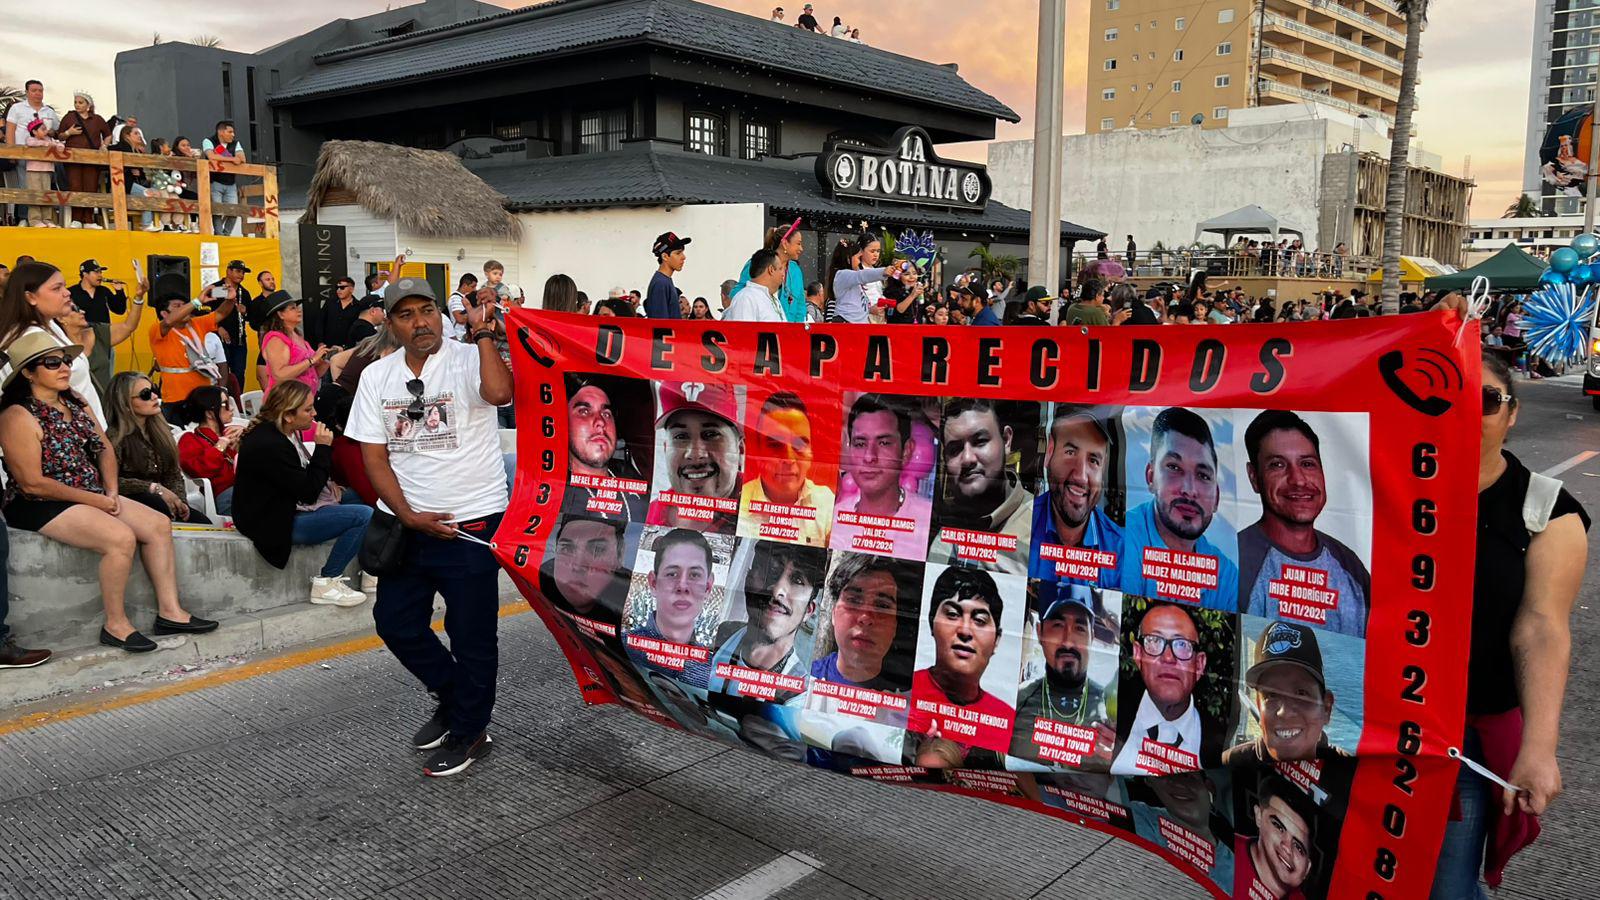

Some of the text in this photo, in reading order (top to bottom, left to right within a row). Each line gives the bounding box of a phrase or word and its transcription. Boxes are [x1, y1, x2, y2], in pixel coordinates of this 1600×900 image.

[900, 136, 926, 162] LA
[860, 155, 959, 200] BOTANA
[596, 324, 1293, 397] DESAPARECIDOS
[571, 475, 590, 485] RAFAEL
[592, 477, 599, 486] DE
[618, 480, 648, 492] ALVARADO
[597, 489, 617, 500] FLORES
[658, 493, 737, 510] LUIS ALEXIS PERAZA TORRES
[749, 502, 816, 518] LUIS ALBERTO RICARDO
[769, 516, 792, 526] ALONSO
[837, 513, 915, 530] JORGE ARMANDO RAMOS
[863, 528, 886, 538] VALDEZ
[941, 530, 1017, 549] CARLOS FAJARDO URIBE
[1040, 545, 1114, 566] RAFAEL CHAVEZ PÉREZ
[1144, 549, 1216, 570] MIGUEL ALEJANDRO
[1055, 561, 1098, 578] 04/10/2024
[1142, 564, 1217, 586] VALDEZ MALDONADO
[1283, 568, 1325, 586] JUAN LUIS
[1156, 581, 1200, 599] 12/10/2024
[1269, 581, 1336, 605] IRIBE RODRÍGUEZ
[1279, 600, 1326, 620] 13/11/2024
[627, 636, 707, 659] ALEJANDRO TRUJILLO CRUZ
[716, 664, 731, 676] JOSÉ
[733, 668, 759, 682] GERARDO
[775, 675, 803, 690] SÁNCHEZ
[839, 686, 855, 698] ALAN
[856, 690, 882, 704] MORENO
[883, 695, 907, 708] SOLANO
[916, 699, 937, 713] MIGUEL
[958, 708, 979, 723] ALZATE
[979, 713, 1008, 729] MENDOZA
[1054, 723, 1094, 741] FRANCISCO
[1034, 732, 1090, 753] QUIROGA TOVAR
[1039, 746, 1081, 764] 13/11/2024
[1137, 754, 1171, 774] GUERRERO
[1144, 741, 1196, 768] VICTOR MANUEL
[1044, 785, 1060, 795] LUIS
[1061, 789, 1077, 799] ABEL
[1079, 794, 1104, 809] AMAYA
